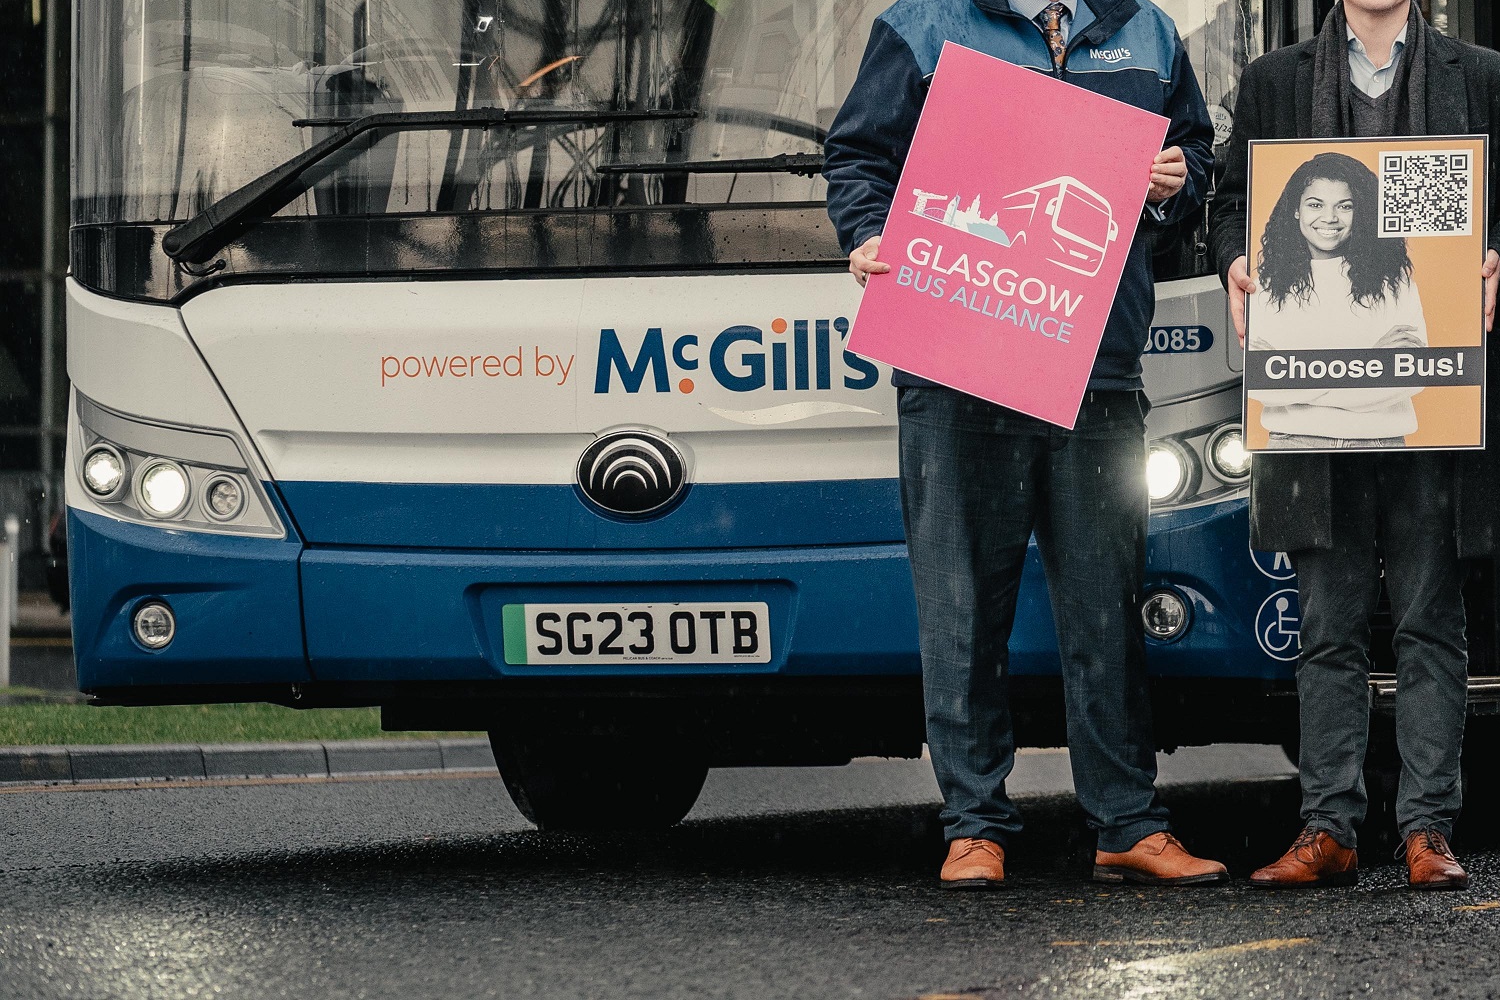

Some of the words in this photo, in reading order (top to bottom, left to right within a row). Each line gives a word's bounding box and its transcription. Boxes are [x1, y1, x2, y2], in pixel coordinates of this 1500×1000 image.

[896, 264, 946, 299] BUS
[948, 286, 1076, 344] ALLIANCE
[906, 237, 1085, 318] GLASGOW
[380, 345, 523, 388] powered
[534, 345, 575, 388] by
[593, 315, 880, 395] McGill's
[1264, 355, 1384, 381] Choose
[1394, 353, 1465, 377] Bus!
[535, 611, 655, 656] SG23
[669, 610, 759, 655] OTB
